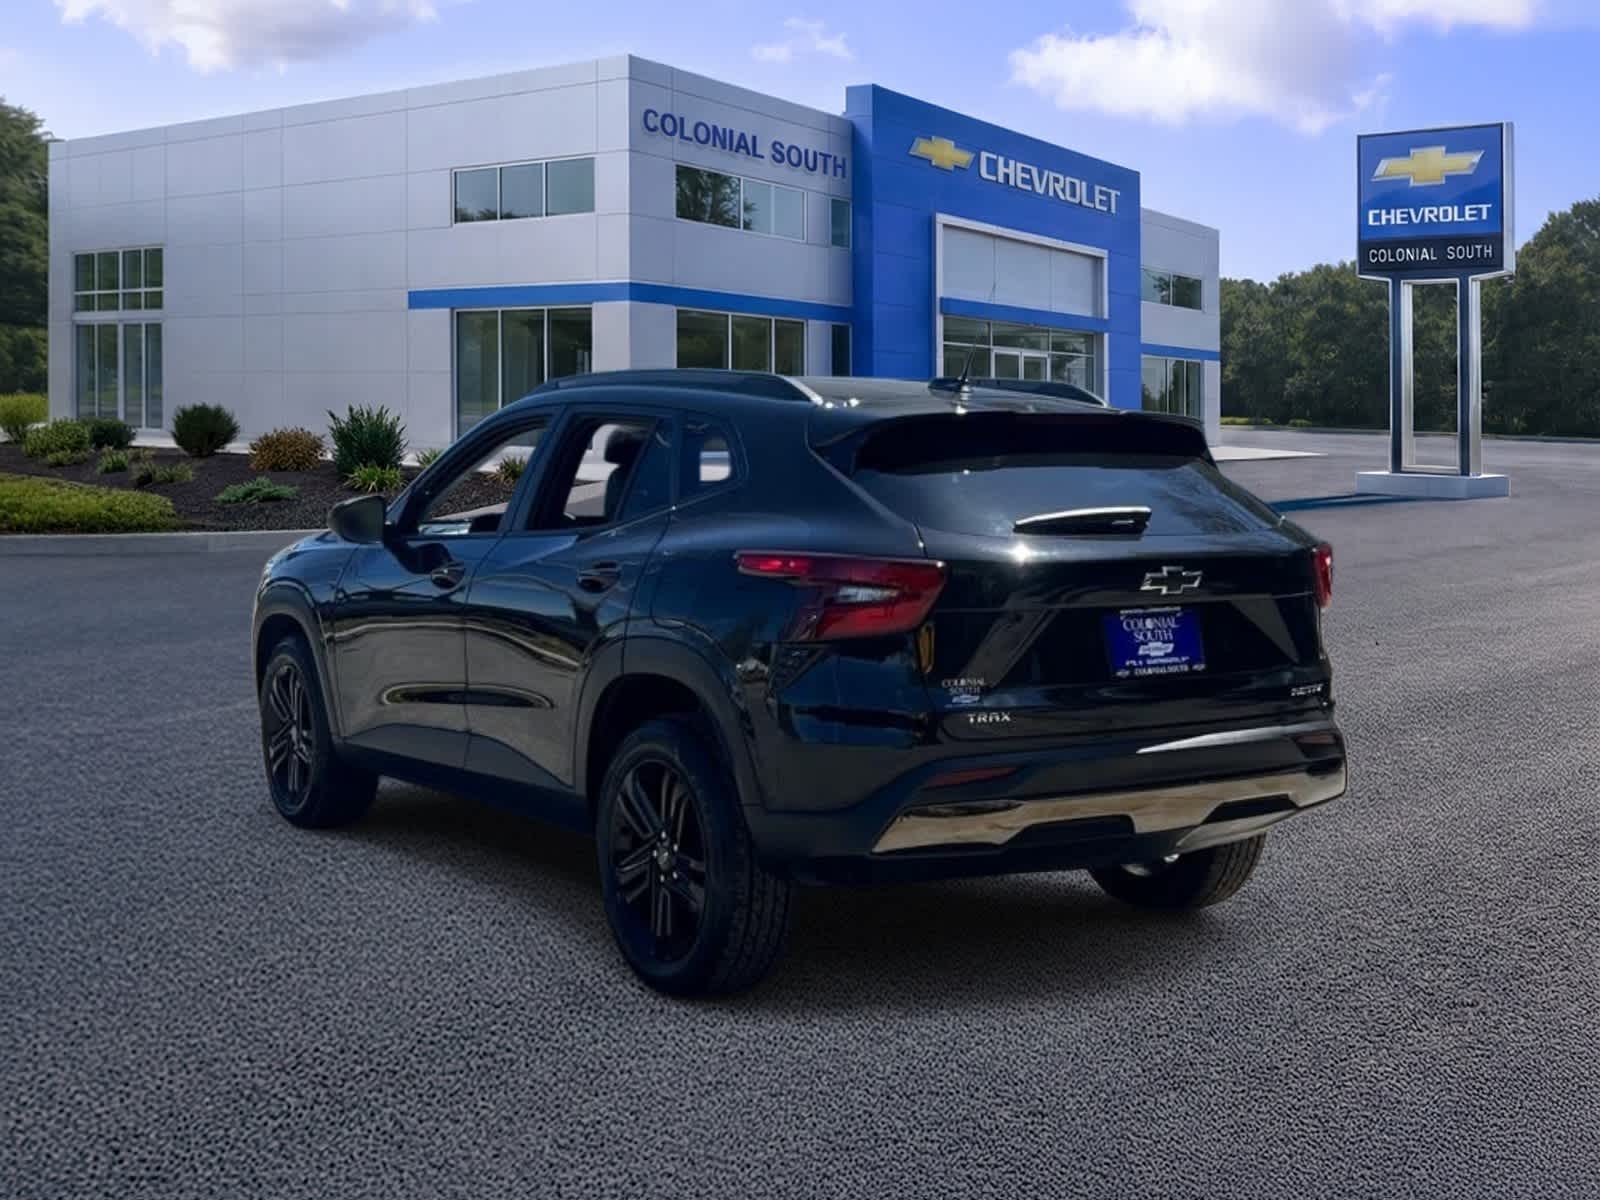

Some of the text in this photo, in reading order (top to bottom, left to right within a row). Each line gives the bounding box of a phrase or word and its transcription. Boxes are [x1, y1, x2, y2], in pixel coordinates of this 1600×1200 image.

[642, 108, 847, 180] COLONIAL SOUTH
[979, 150, 1121, 215] CHEVROLET
[1368, 204, 1492, 226] CHEVROLET
[1369, 244, 1493, 263] COLONIAL SOUTH
[1134, 629, 1174, 642] SOUTH
[967, 712, 1011, 723] TRAX
